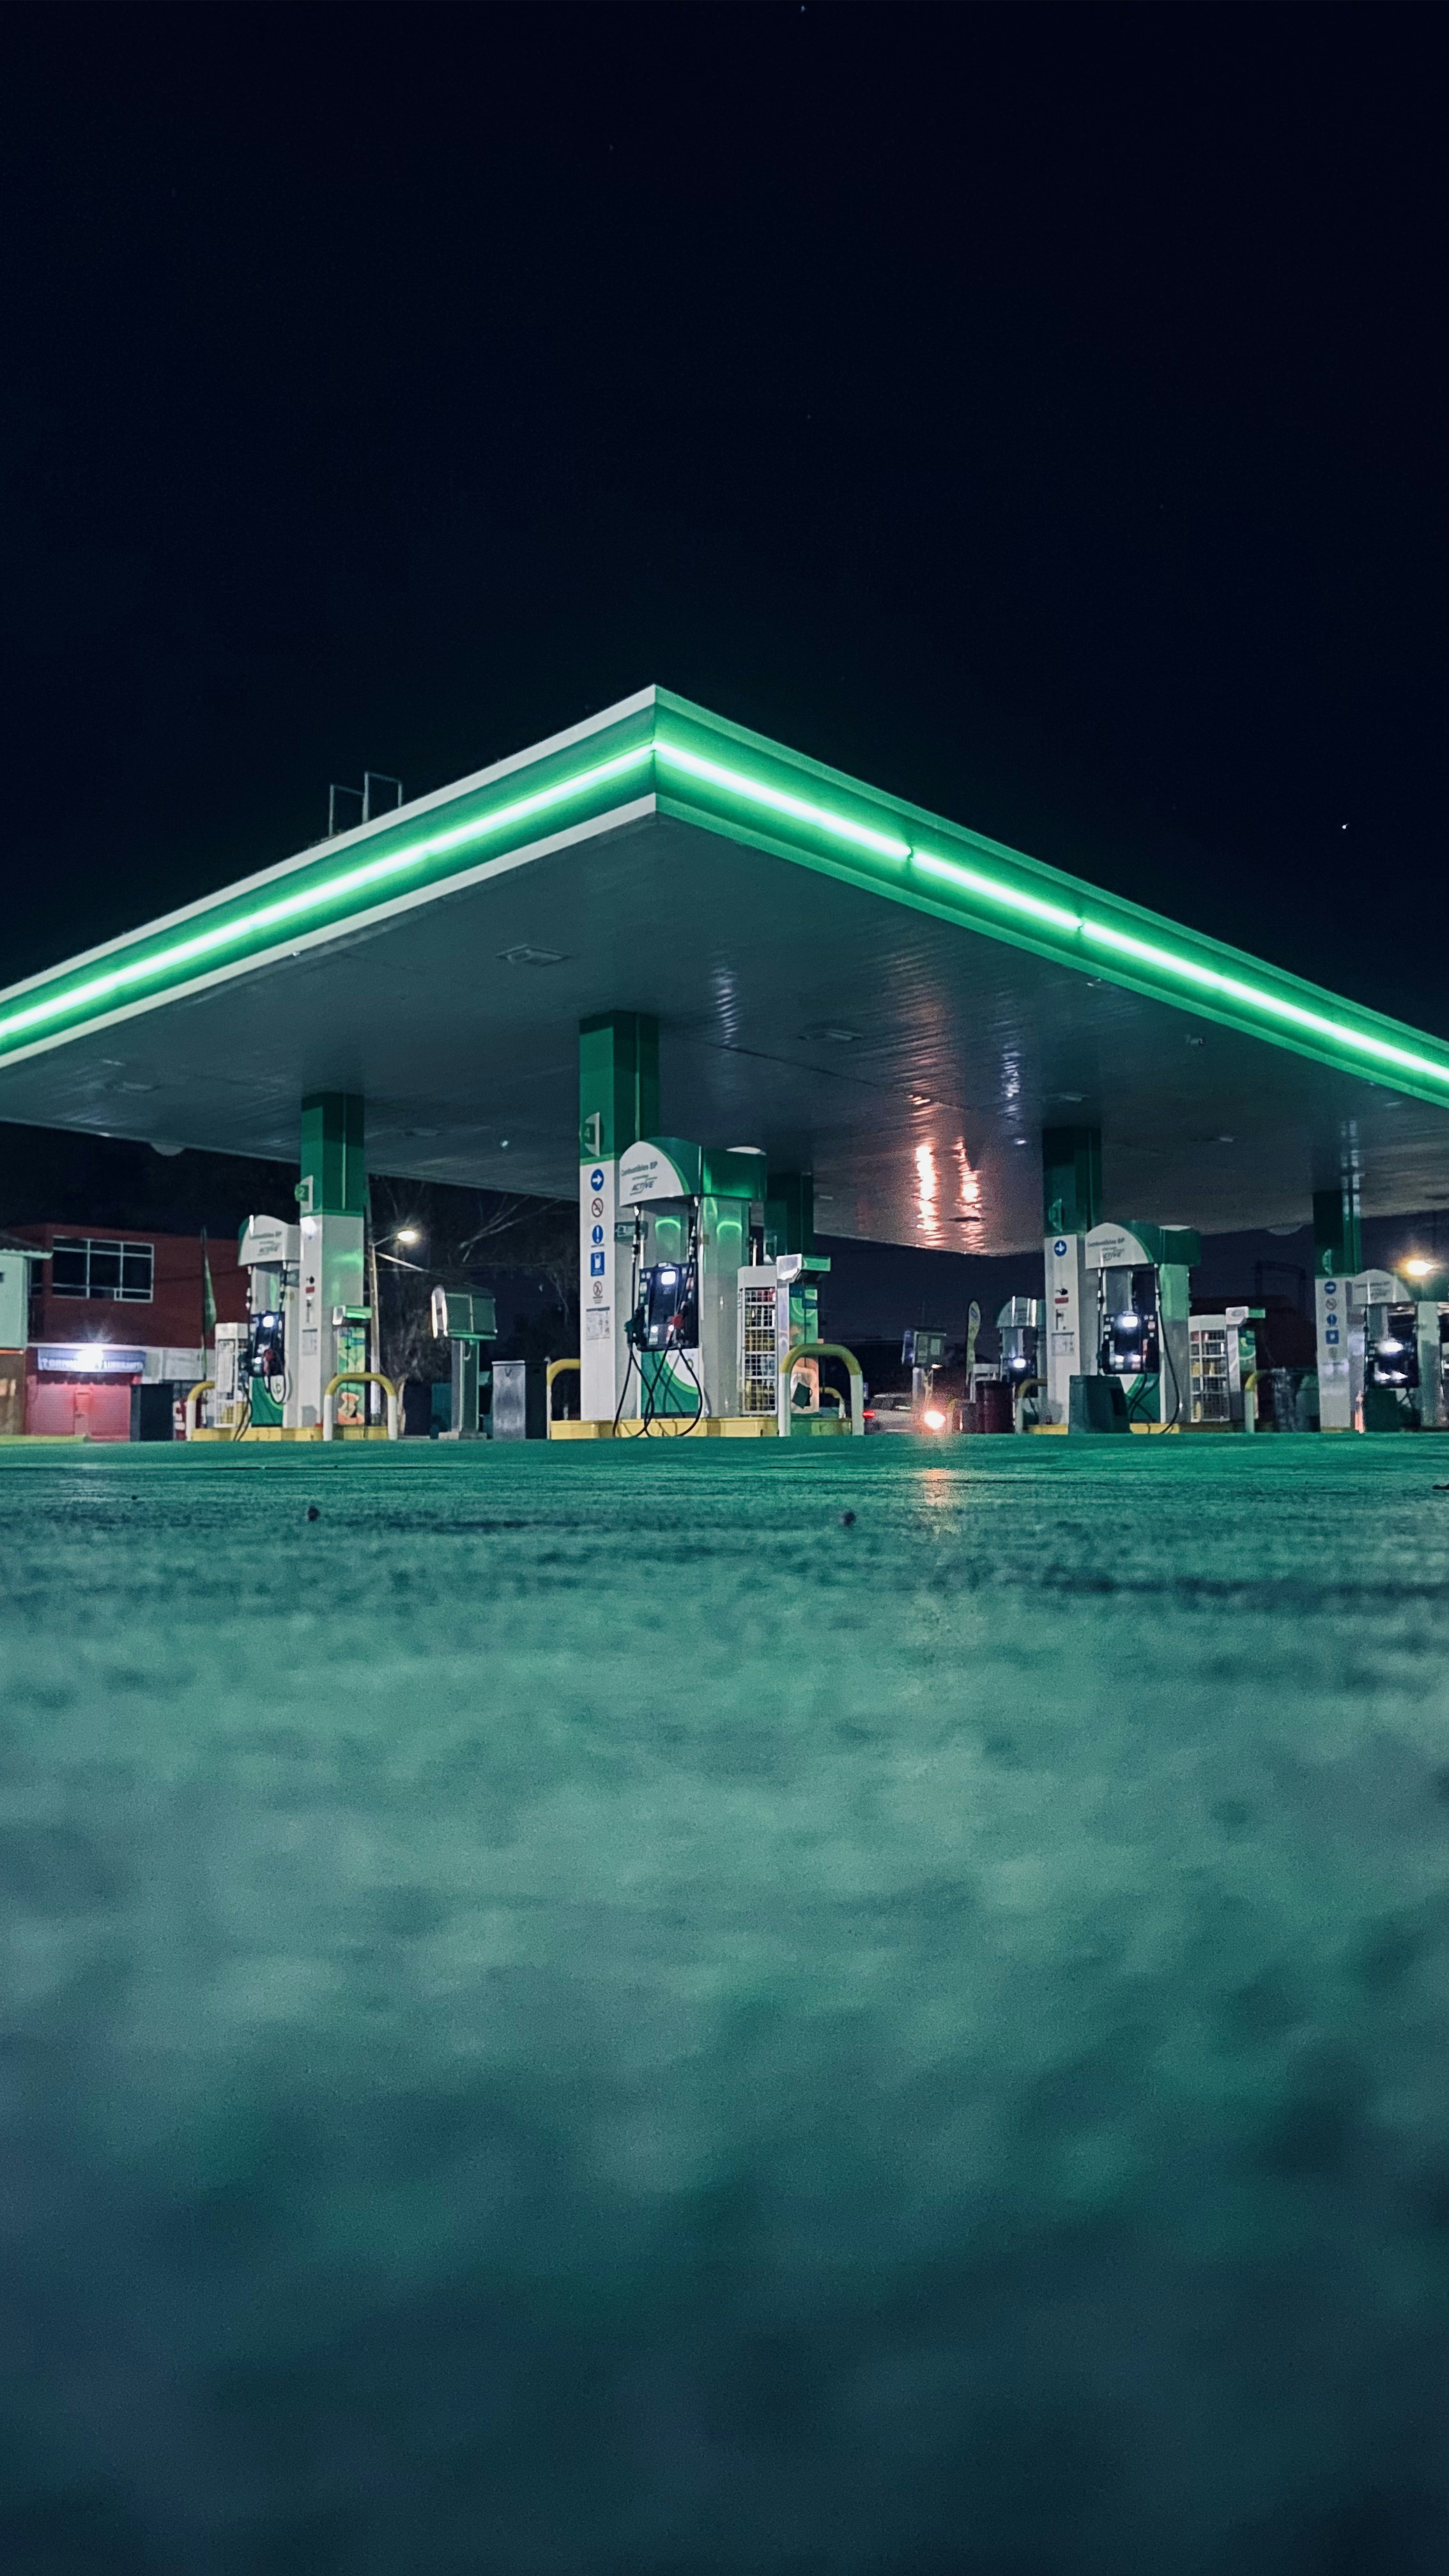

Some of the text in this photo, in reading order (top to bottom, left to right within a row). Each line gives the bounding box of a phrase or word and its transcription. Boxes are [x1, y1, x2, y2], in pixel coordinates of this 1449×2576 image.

[621, 1161, 657, 1177] Combustibles BP
[631, 1181, 654, 1191] ACTIVE
[298, 1187, 305, 1198] 2
